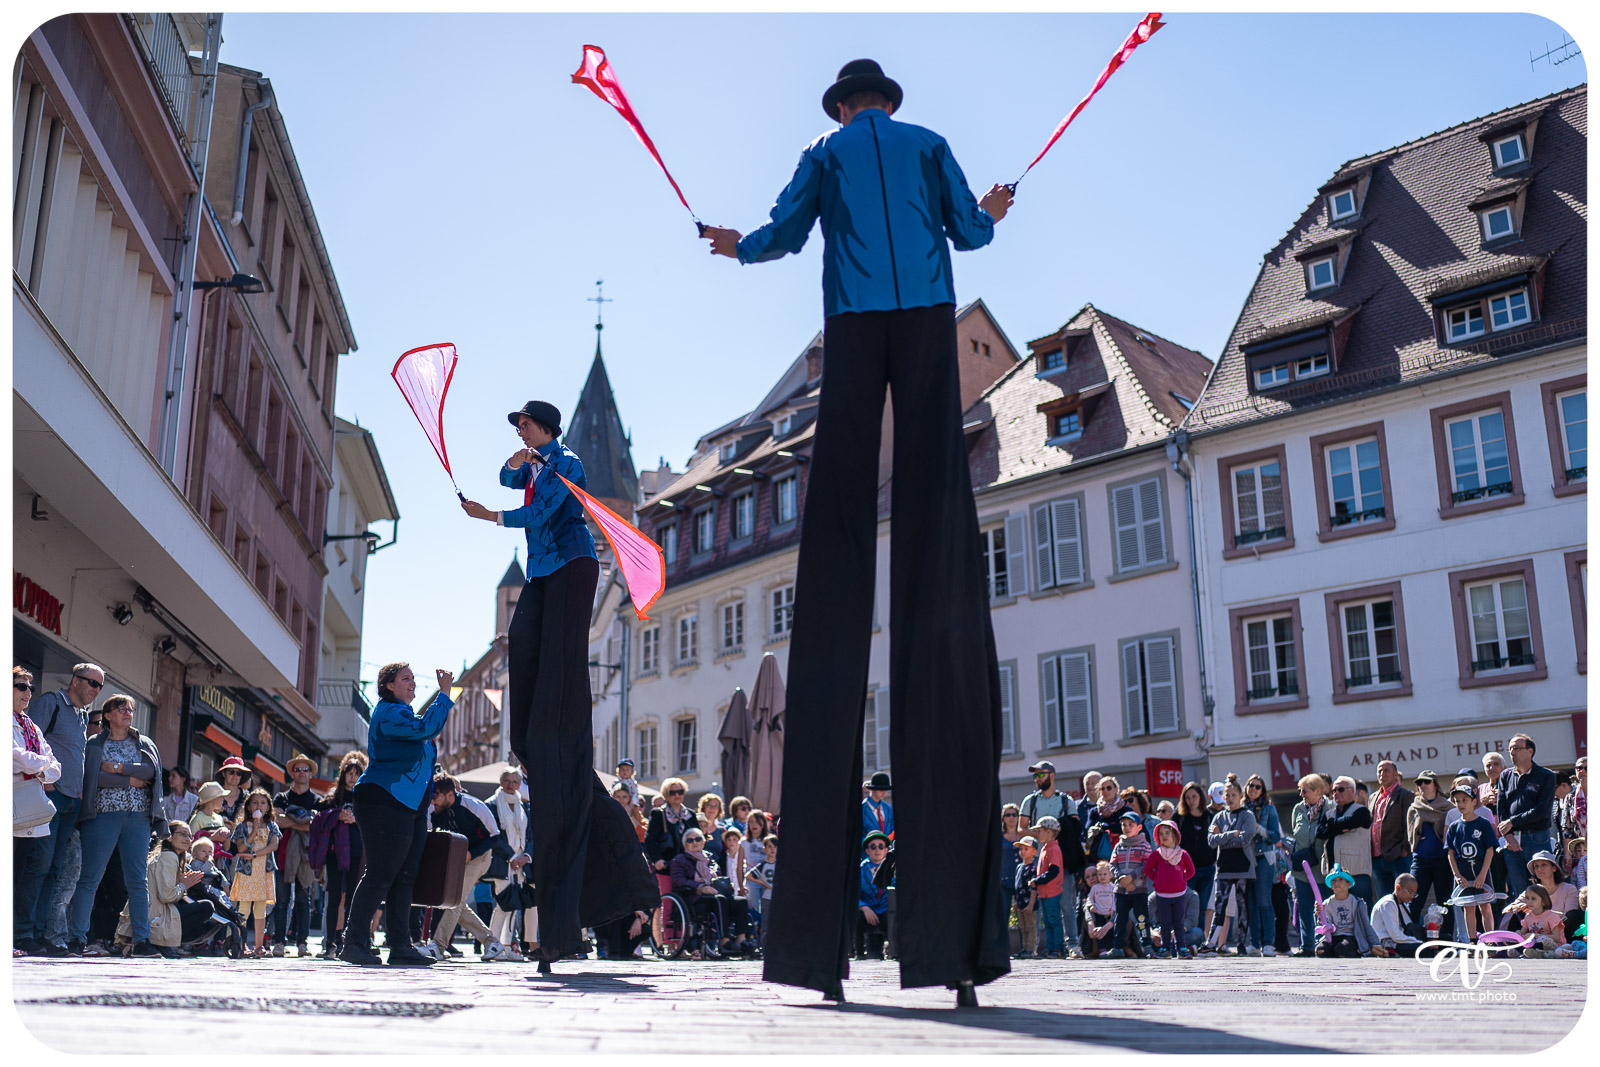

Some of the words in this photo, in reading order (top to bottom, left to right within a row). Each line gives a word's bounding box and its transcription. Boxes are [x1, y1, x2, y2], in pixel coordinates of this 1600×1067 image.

[199, 685, 235, 721] CHOCOLATIER
[1350, 746, 1439, 767] ARMAND
[1452, 738, 1511, 756] THIE
[1159, 769, 1183, 785] SFR
